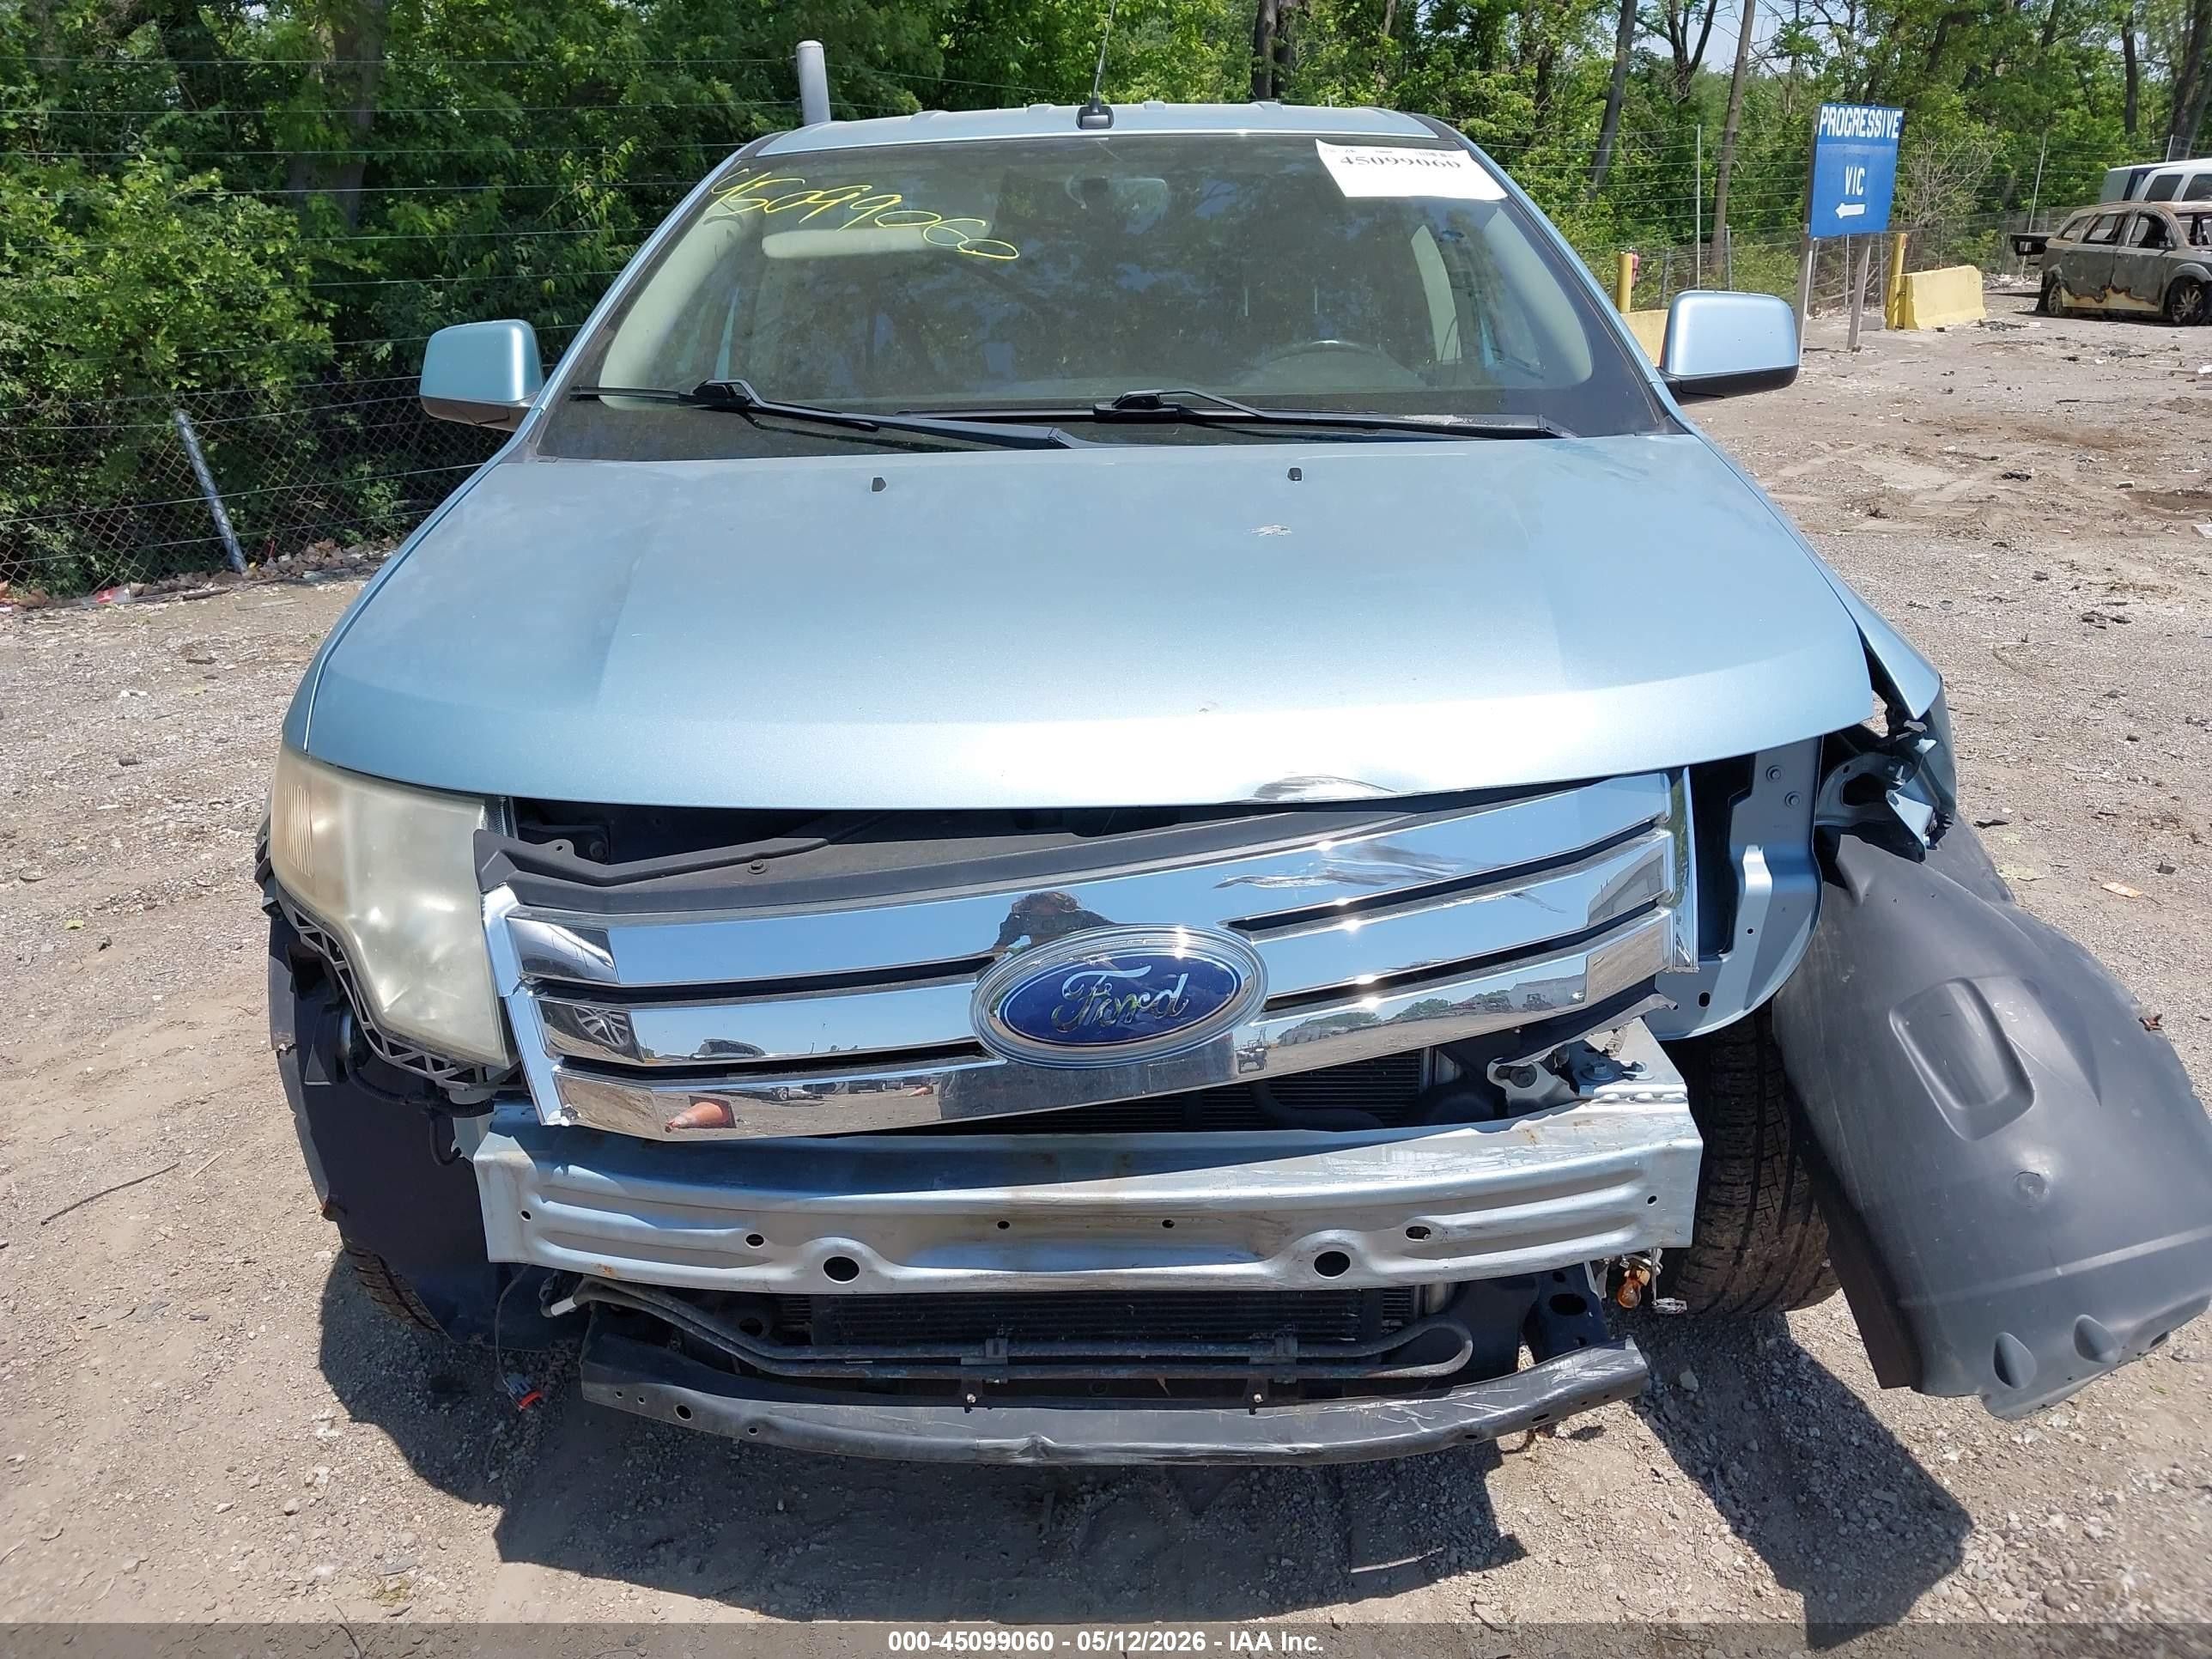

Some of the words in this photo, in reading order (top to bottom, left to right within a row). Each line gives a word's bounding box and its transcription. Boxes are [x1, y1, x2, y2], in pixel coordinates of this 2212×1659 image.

[1818, 106, 1904, 139] PROGRESSIVE
[1339, 155, 1462, 169] 45099060
[1844, 165, 1866, 197] VIC
[1050, 964, 1190, 1034] Ford
